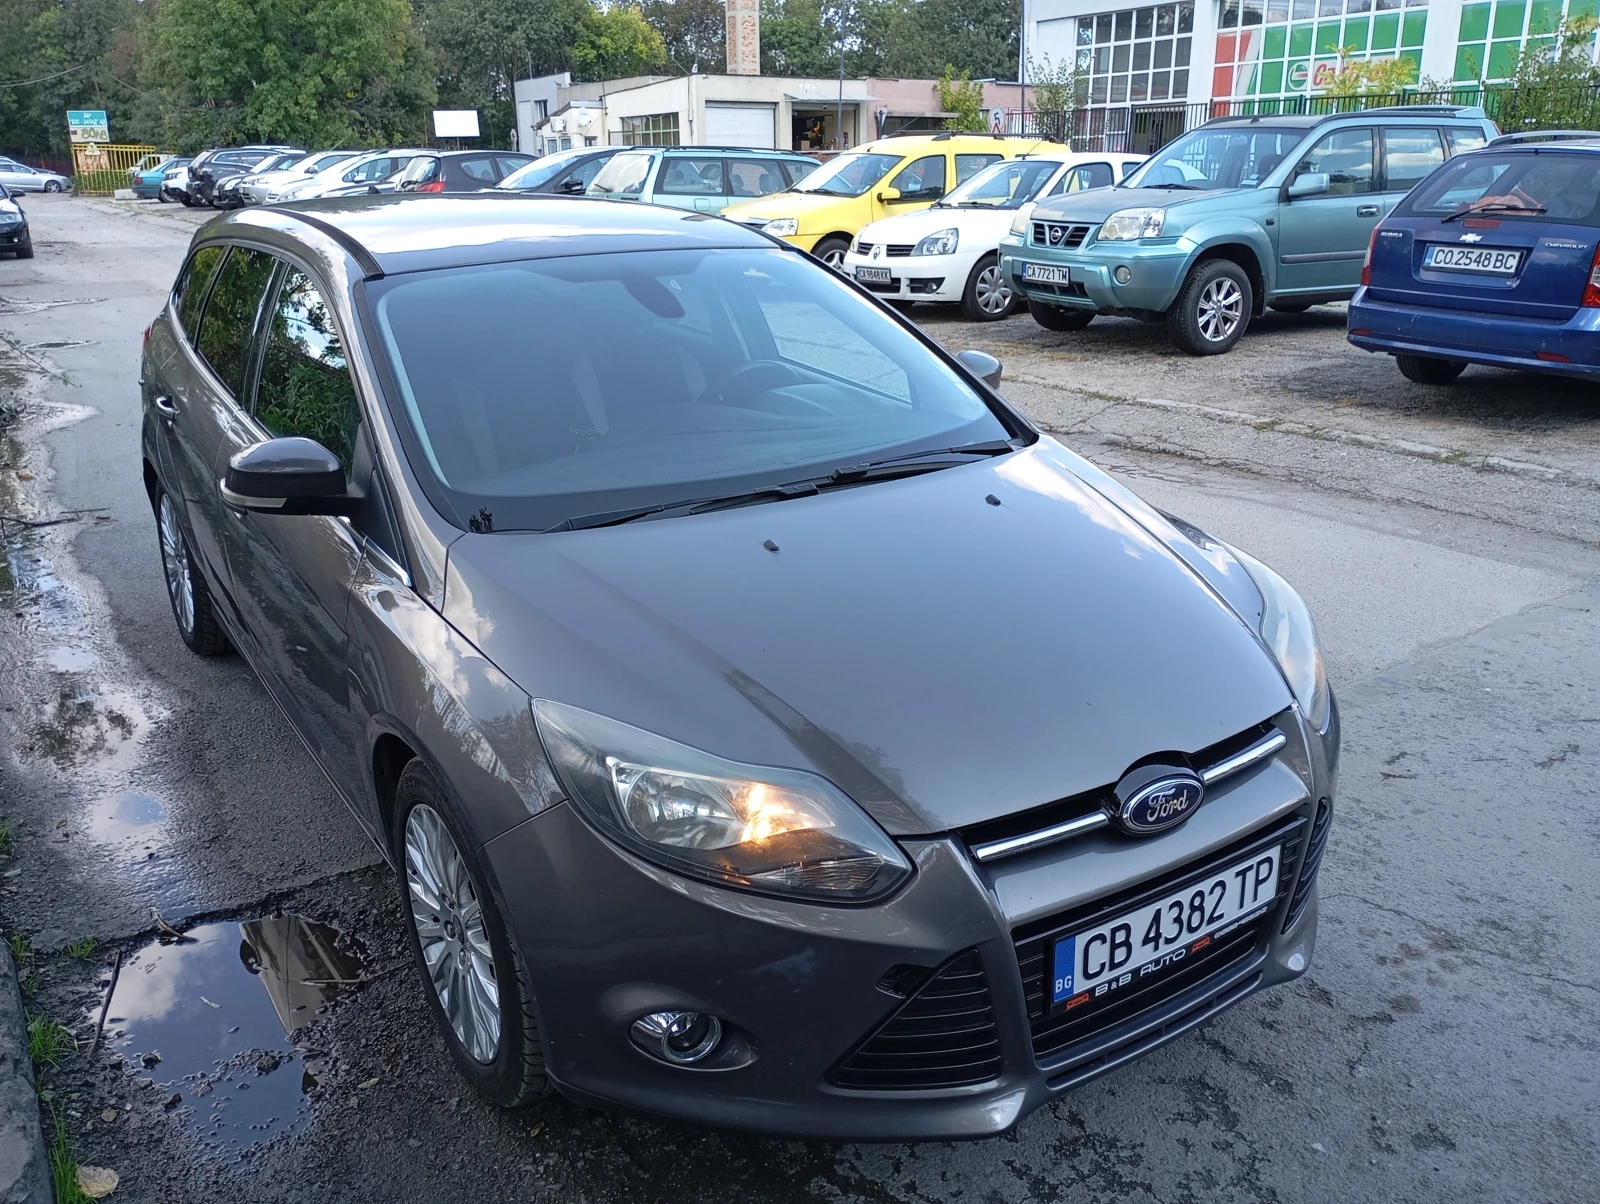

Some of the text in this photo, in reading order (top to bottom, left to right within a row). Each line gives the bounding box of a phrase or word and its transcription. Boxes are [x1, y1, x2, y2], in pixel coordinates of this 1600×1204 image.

[1037, 267, 1055, 280] 7721
[1493, 253, 1516, 270] BC
[1147, 788, 1188, 822] Ford
[1083, 922, 1133, 980] CB
[1141, 879, 1226, 952] 4382
[1235, 855, 1274, 910] TP
[1055, 975, 1072, 993] BG
[1095, 948, 1186, 997] B&B AUTO
